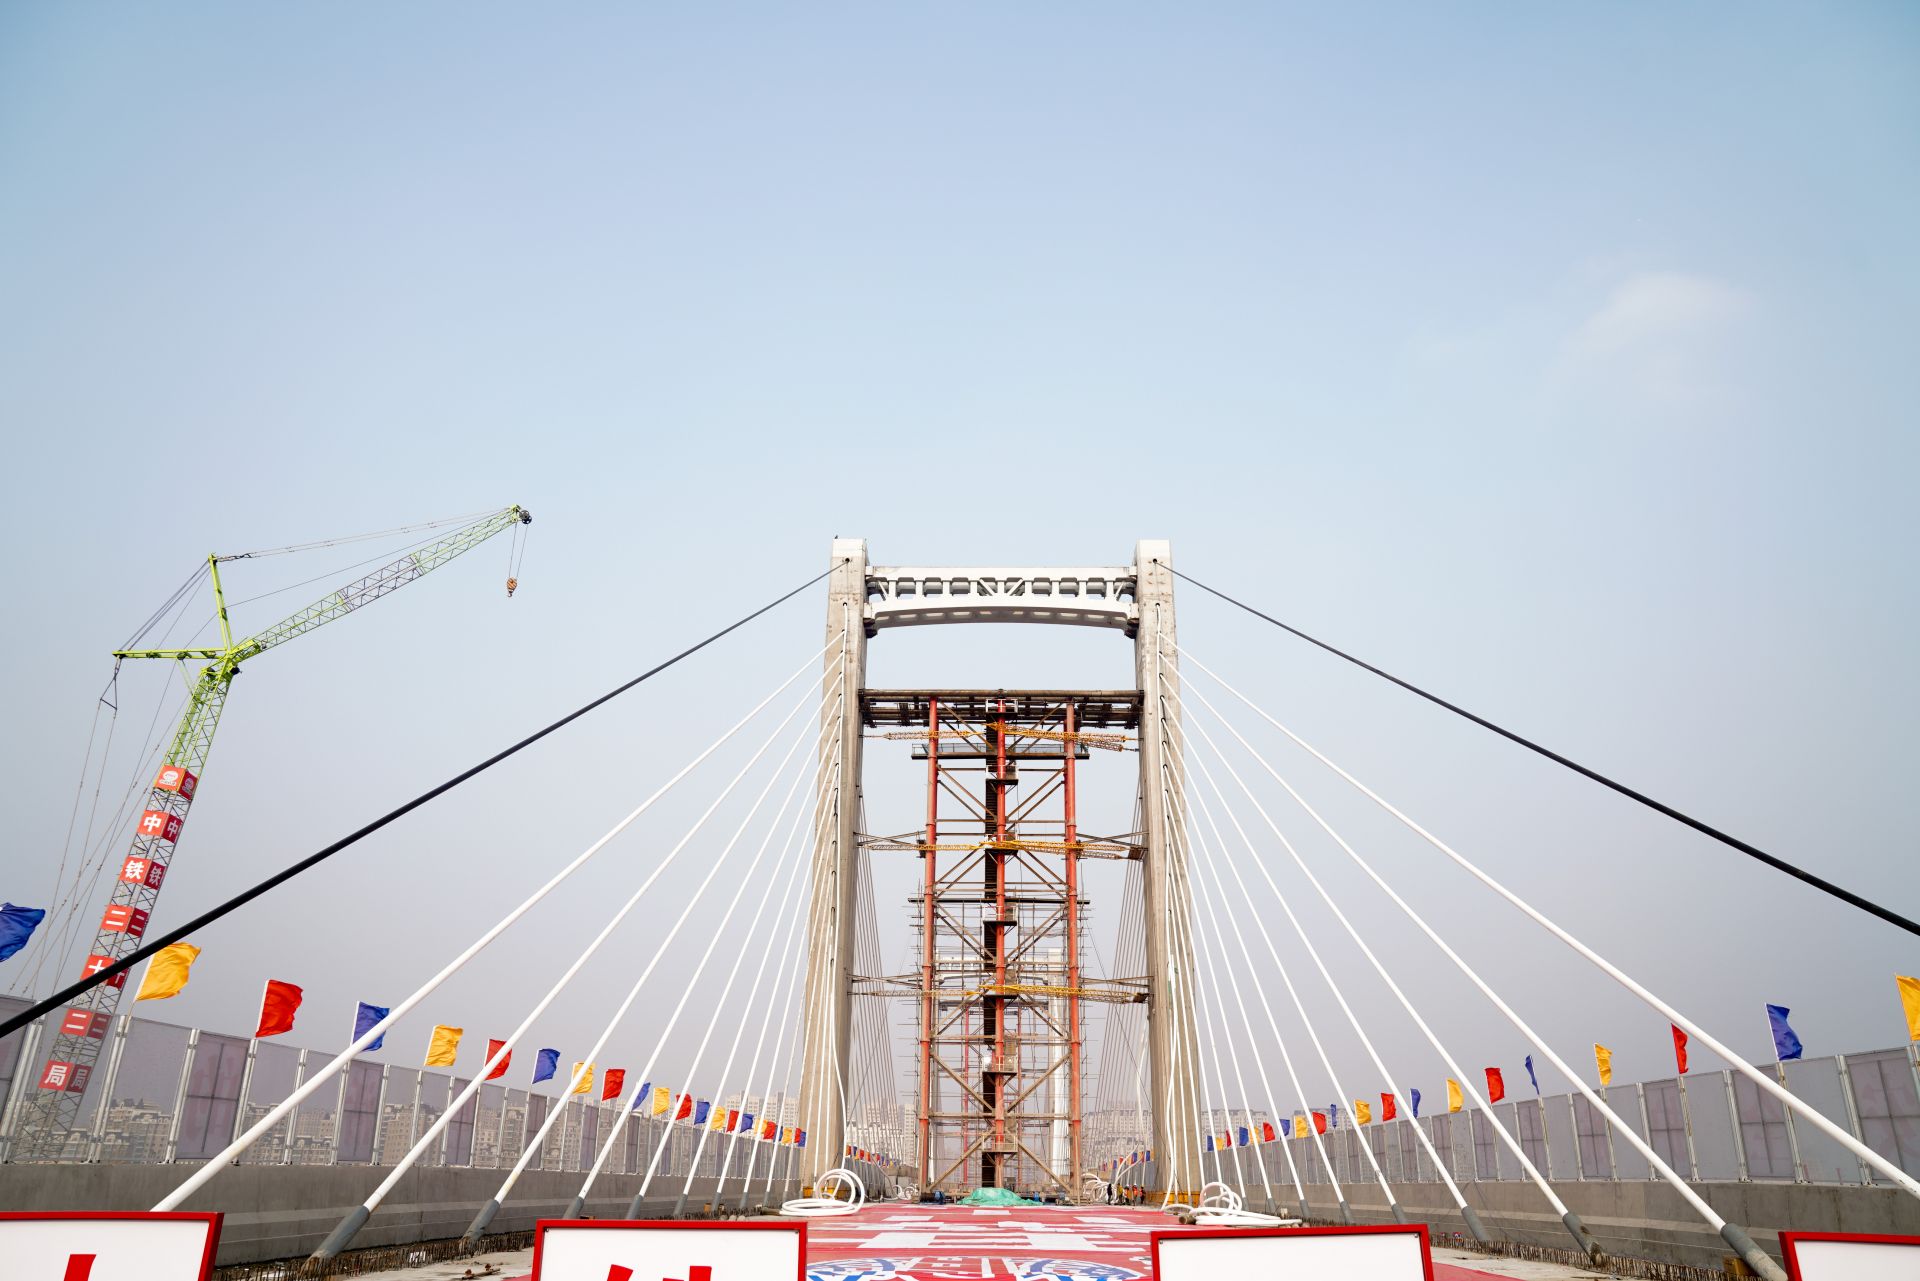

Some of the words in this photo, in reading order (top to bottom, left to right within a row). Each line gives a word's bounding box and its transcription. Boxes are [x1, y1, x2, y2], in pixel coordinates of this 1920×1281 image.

[44, 814, 163, 1087] 中铁二十二局
